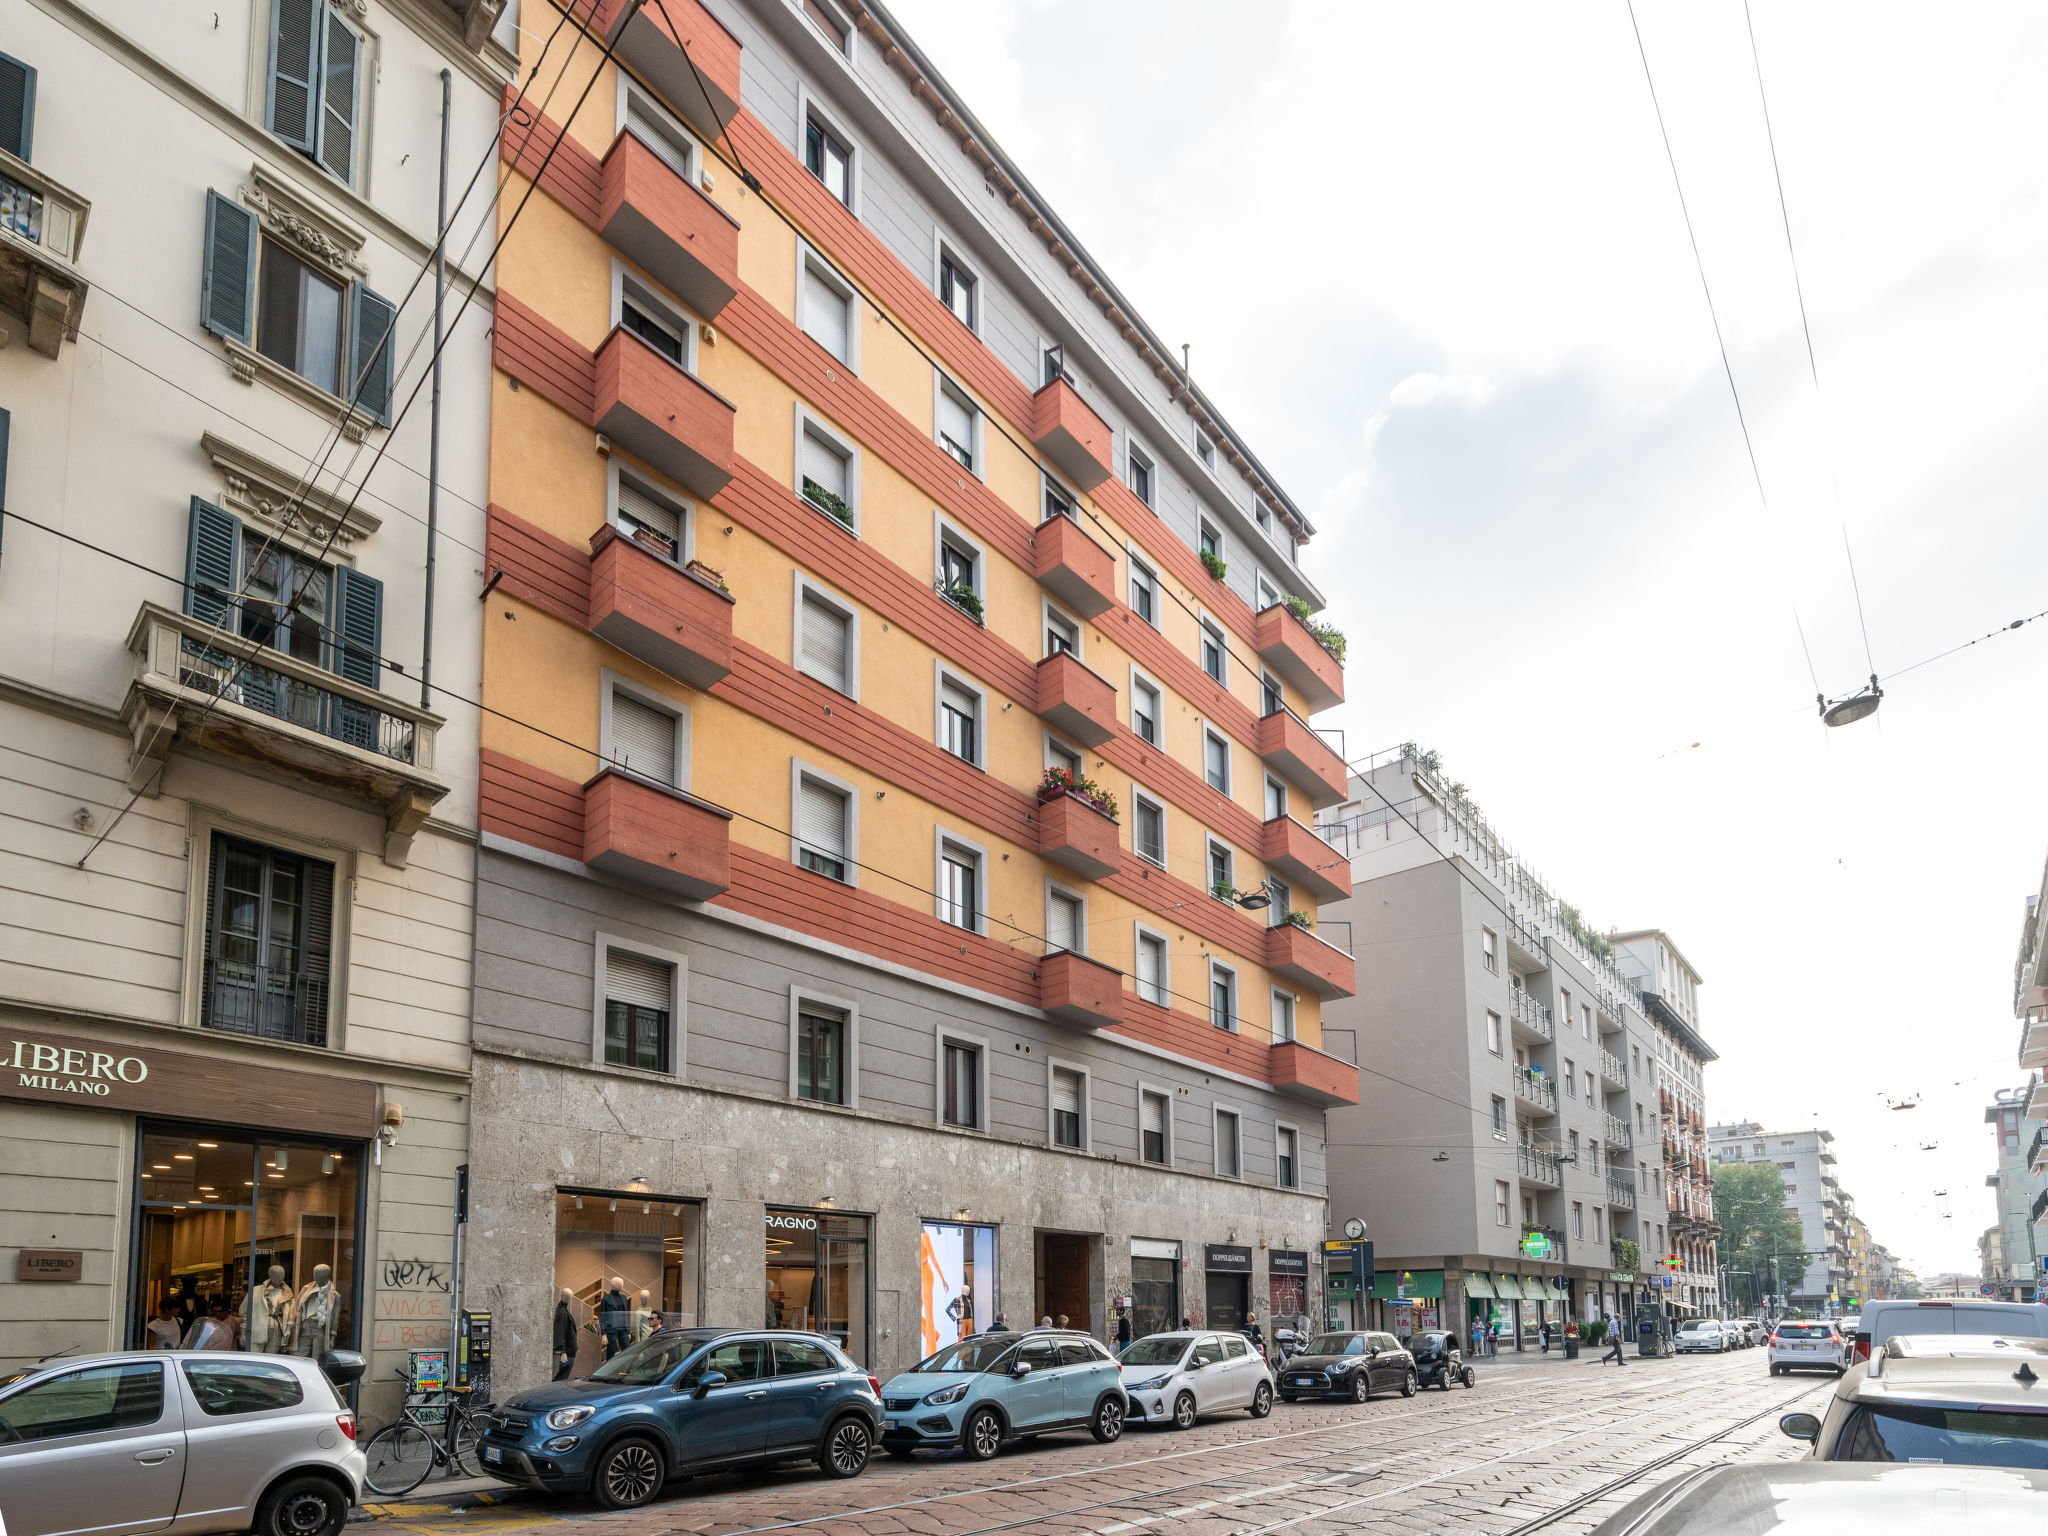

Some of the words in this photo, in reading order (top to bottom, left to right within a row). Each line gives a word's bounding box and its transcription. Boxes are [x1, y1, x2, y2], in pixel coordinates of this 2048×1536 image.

[18, 1073, 110, 1096] MILANO
[765, 1215, 817, 1230] RAGNO
[27, 1258, 74, 1268] LIBERO
[381, 1296, 443, 1316] VINCE
